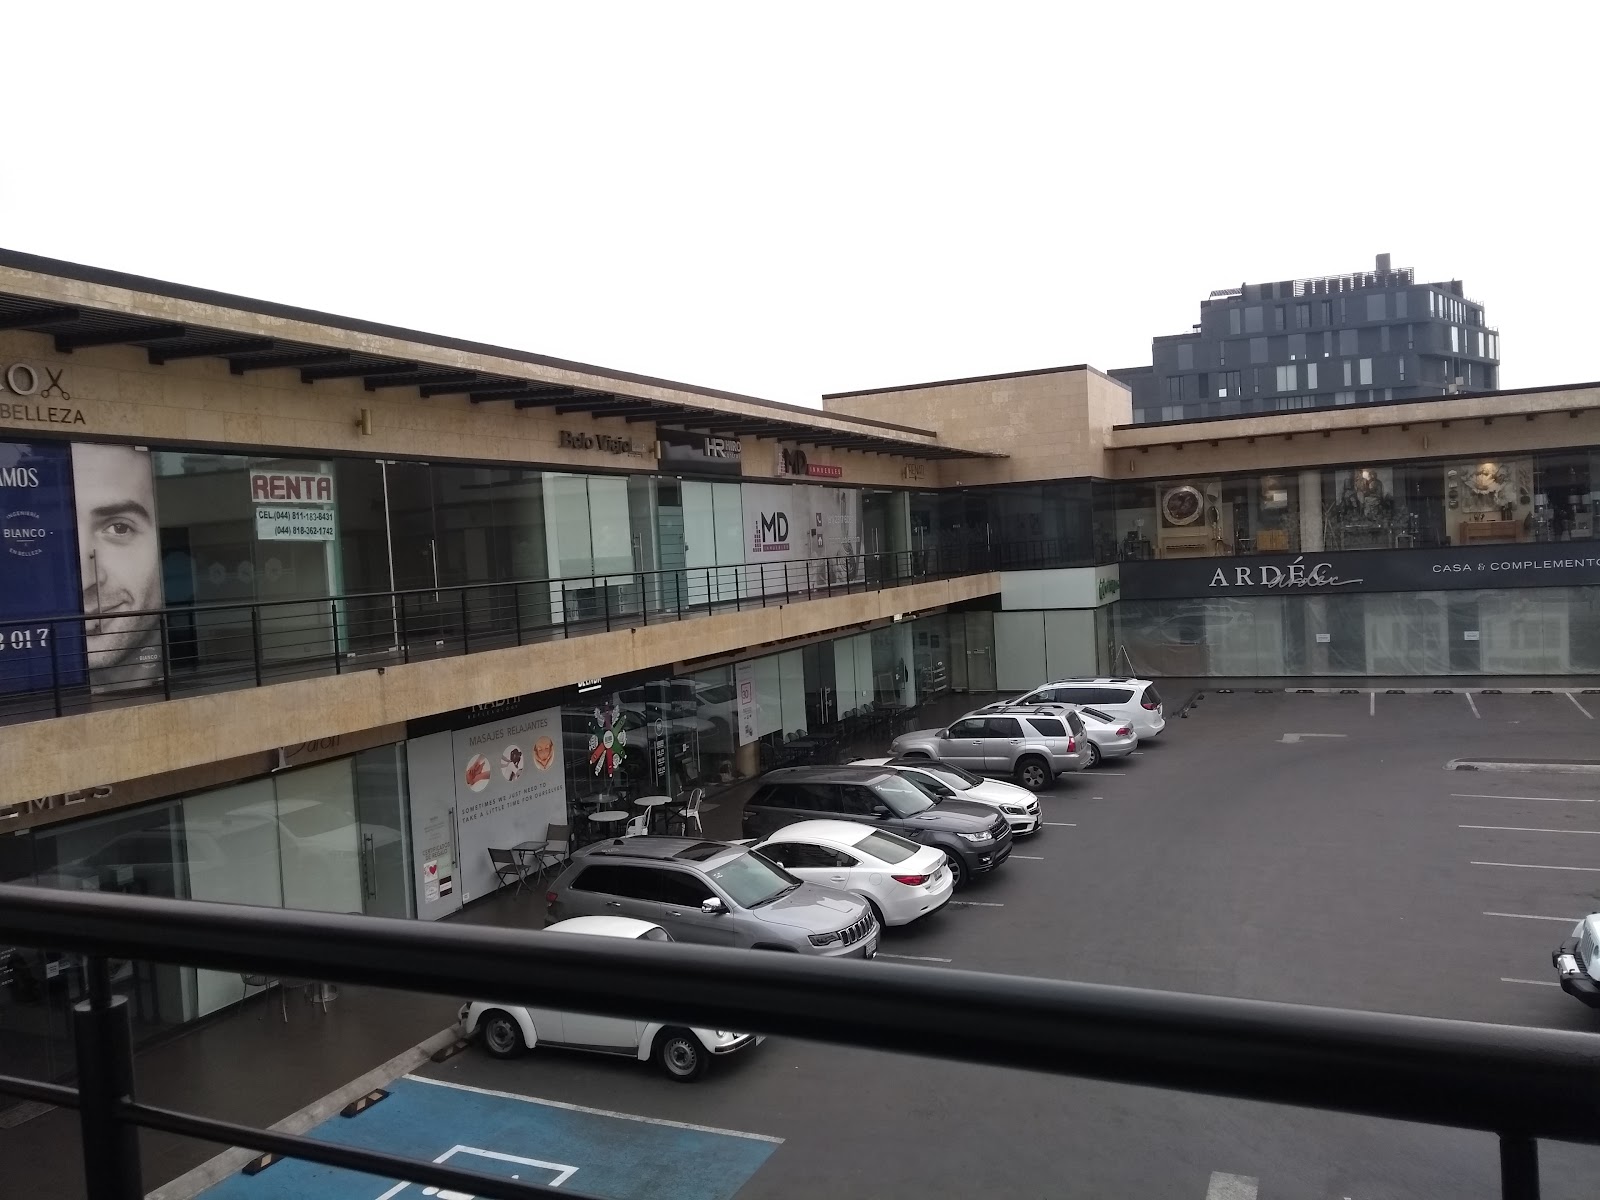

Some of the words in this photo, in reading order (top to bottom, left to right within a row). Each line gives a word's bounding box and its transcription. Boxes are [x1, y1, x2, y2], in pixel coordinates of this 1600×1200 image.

[0, 403, 86, 425] BELLEZA
[782, 448, 808, 475] MD
[251, 474, 332, 501] RENTA
[761, 511, 789, 544] MD
[1208, 555, 1333, 588] ARDÉC
[1432, 563, 1472, 573] CASA
[1477, 562, 1486, 571] &
[469, 728, 504, 747] MASAJES
[507, 718, 549, 737] RELAJANTES
[461, 798, 496, 815] SOMETIMES
[498, 795, 507, 803] WE
[508, 791, 522, 799] JUST
[523, 785, 538, 794] NEED
[462, 813, 477, 824] TAKE
[486, 805, 505, 816] LITTLE
[506, 800, 521, 808] TIME
[522, 795, 533, 804] FOR
[534, 784, 563, 799] OURSELVES
